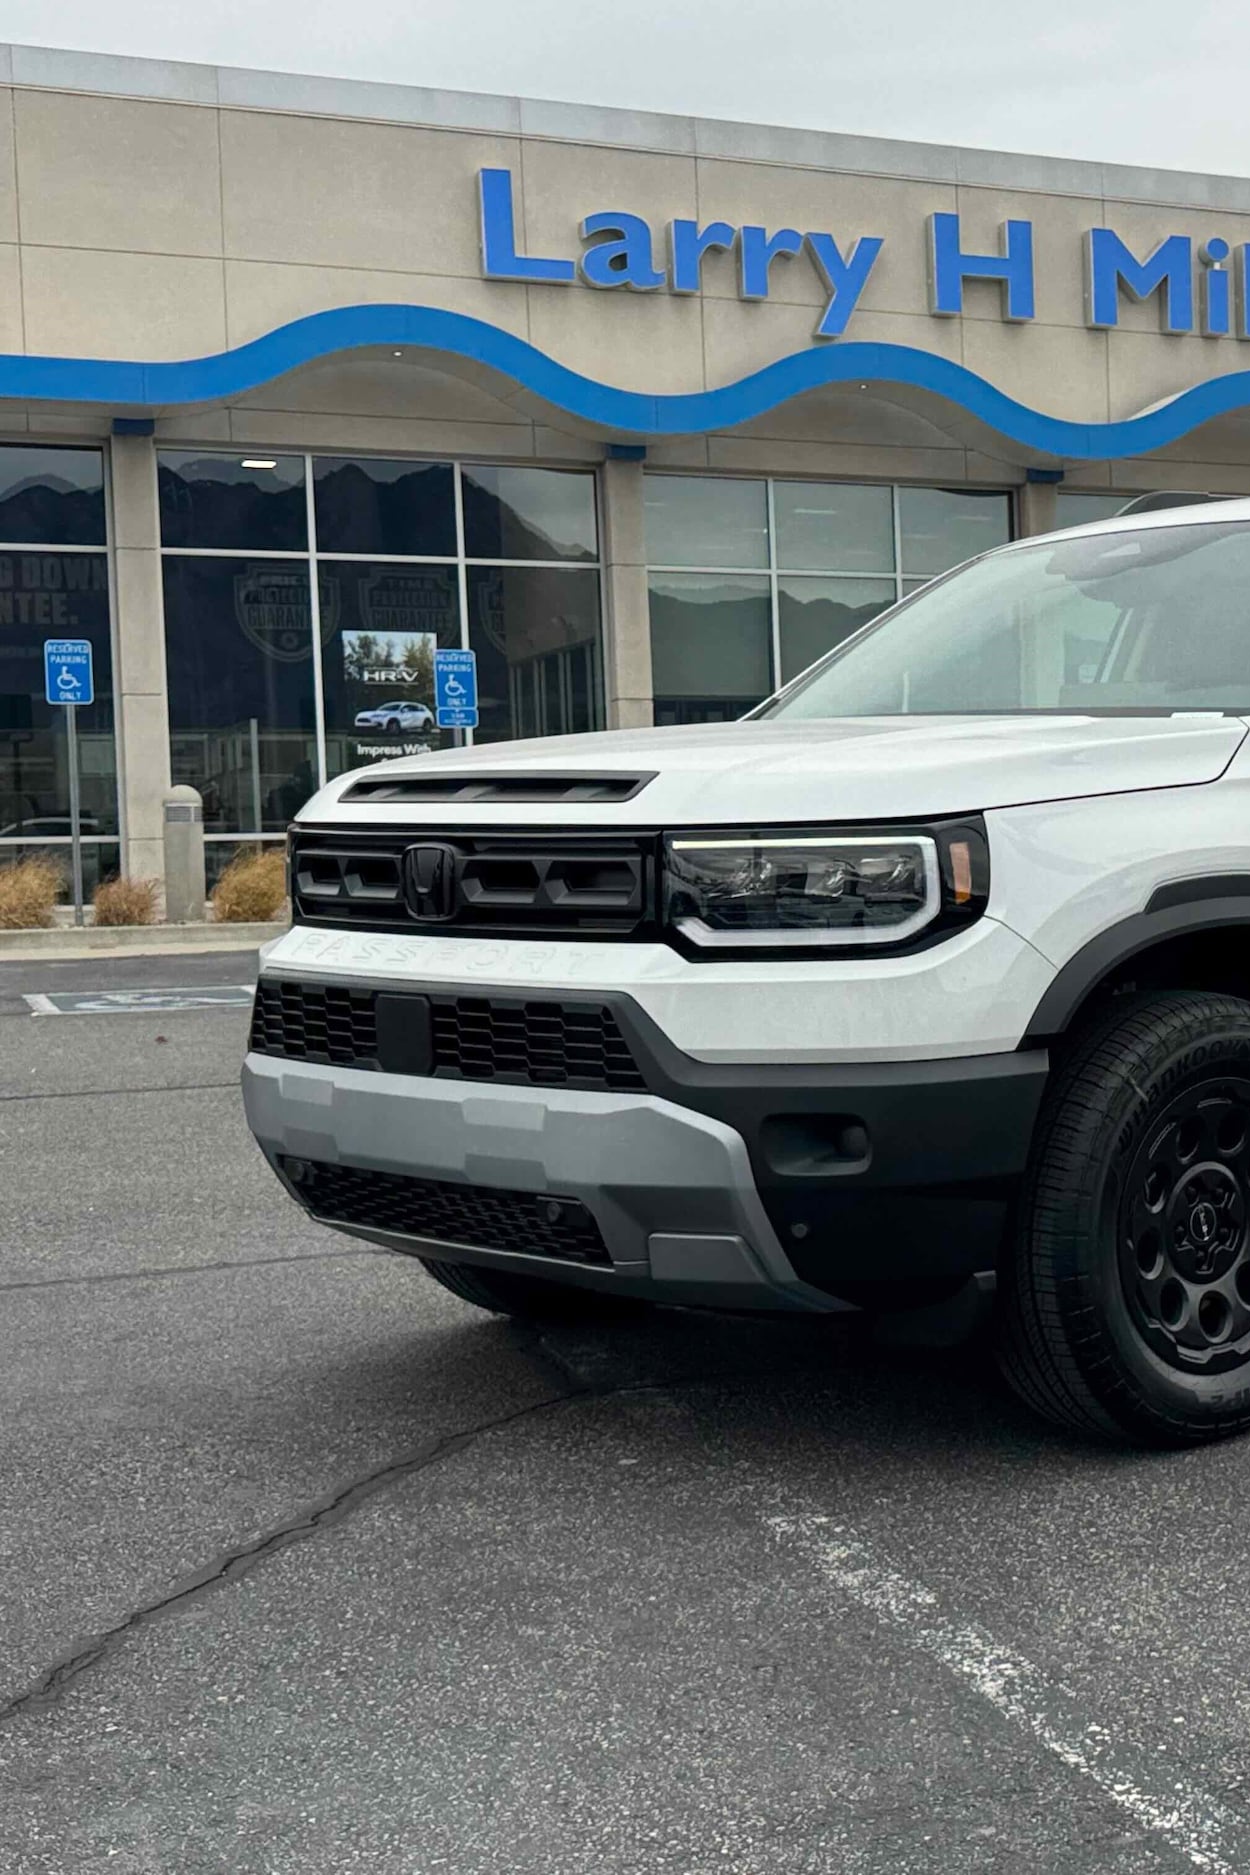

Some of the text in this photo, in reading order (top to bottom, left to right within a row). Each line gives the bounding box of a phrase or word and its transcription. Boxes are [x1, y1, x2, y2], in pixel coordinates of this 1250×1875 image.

[477, 168, 884, 337] Larry
[927, 212, 1035, 321] H
[47, 644, 89, 654] RESERVED
[49, 655, 87, 664] PARKING
[436, 653, 474, 662] RESERVED
[438, 663, 472, 673] PARKING
[363, 670, 419, 682] HR-V
[59, 690, 82, 700] ONLY
[447, 697, 467, 707] ONLY
[357, 744, 402, 758] Impress
[291, 933, 604, 975] PASSPORT
